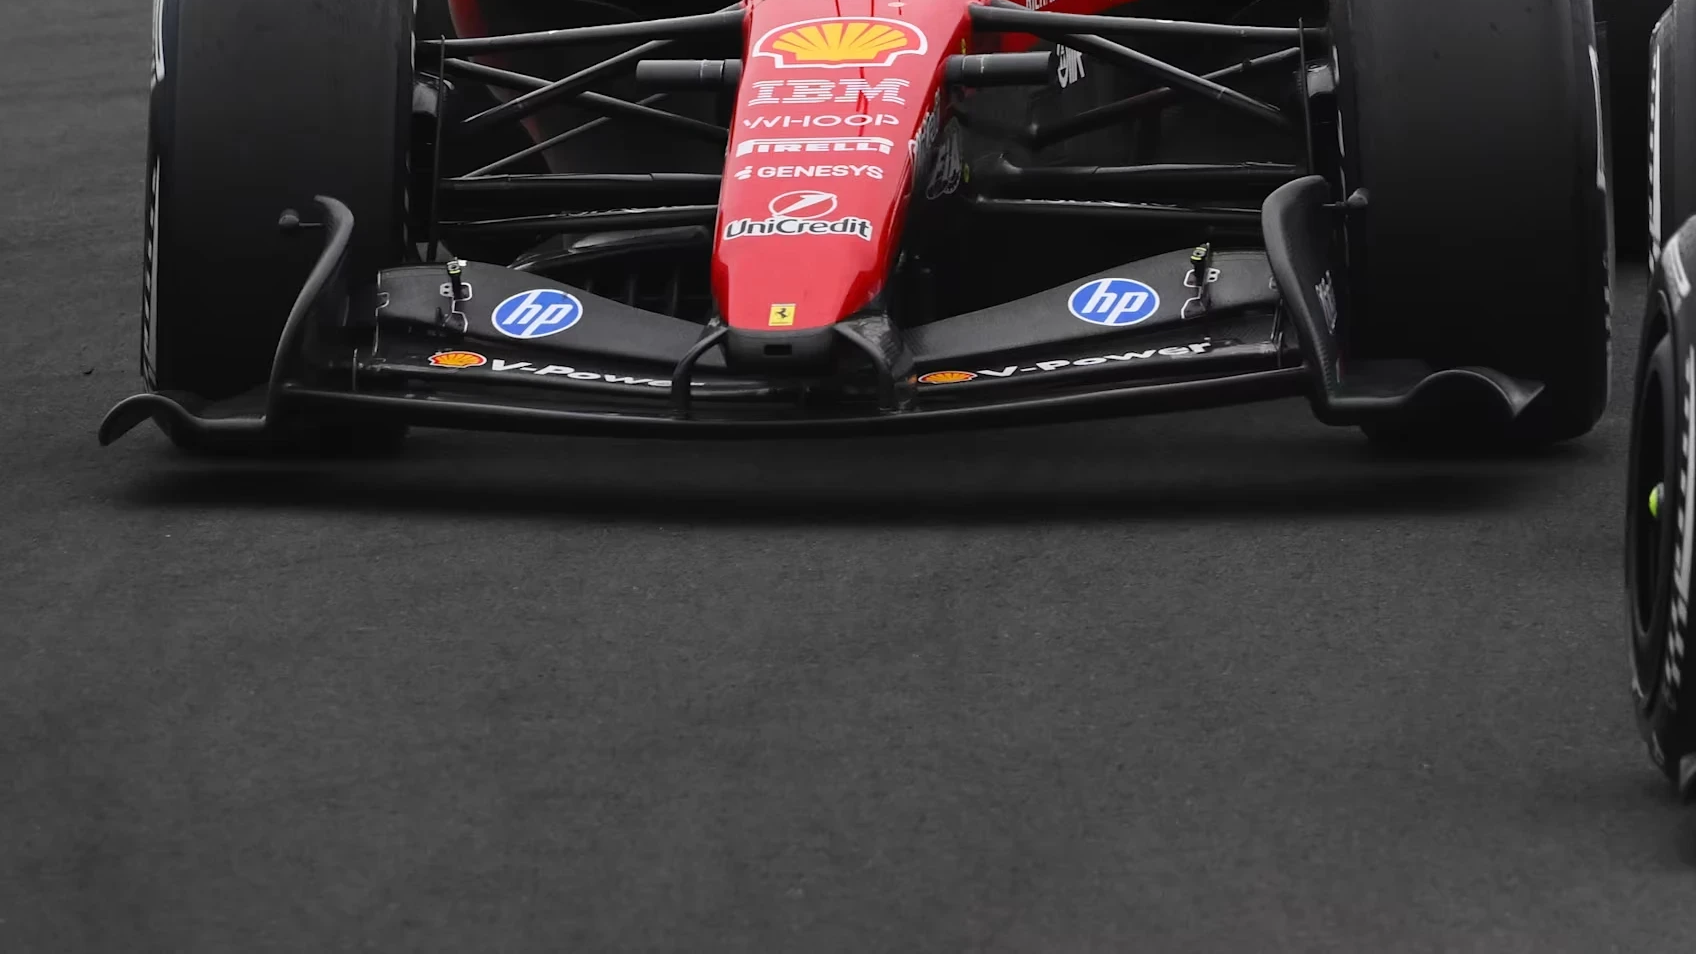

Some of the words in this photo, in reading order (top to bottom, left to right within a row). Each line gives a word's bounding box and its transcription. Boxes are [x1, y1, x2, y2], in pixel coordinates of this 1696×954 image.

[748, 78, 910, 107] IBM
[743, 114, 899, 129] WHOOP
[735, 137, 894, 157] PIRELLI
[757, 165, 883, 179] GENESYS
[725, 218, 870, 239] UniCredit
[502, 290, 573, 337] hp
[1082, 278, 1149, 326] hp
[491, 359, 704, 387] V-Powe
[979, 339, 1212, 379] V-Power
